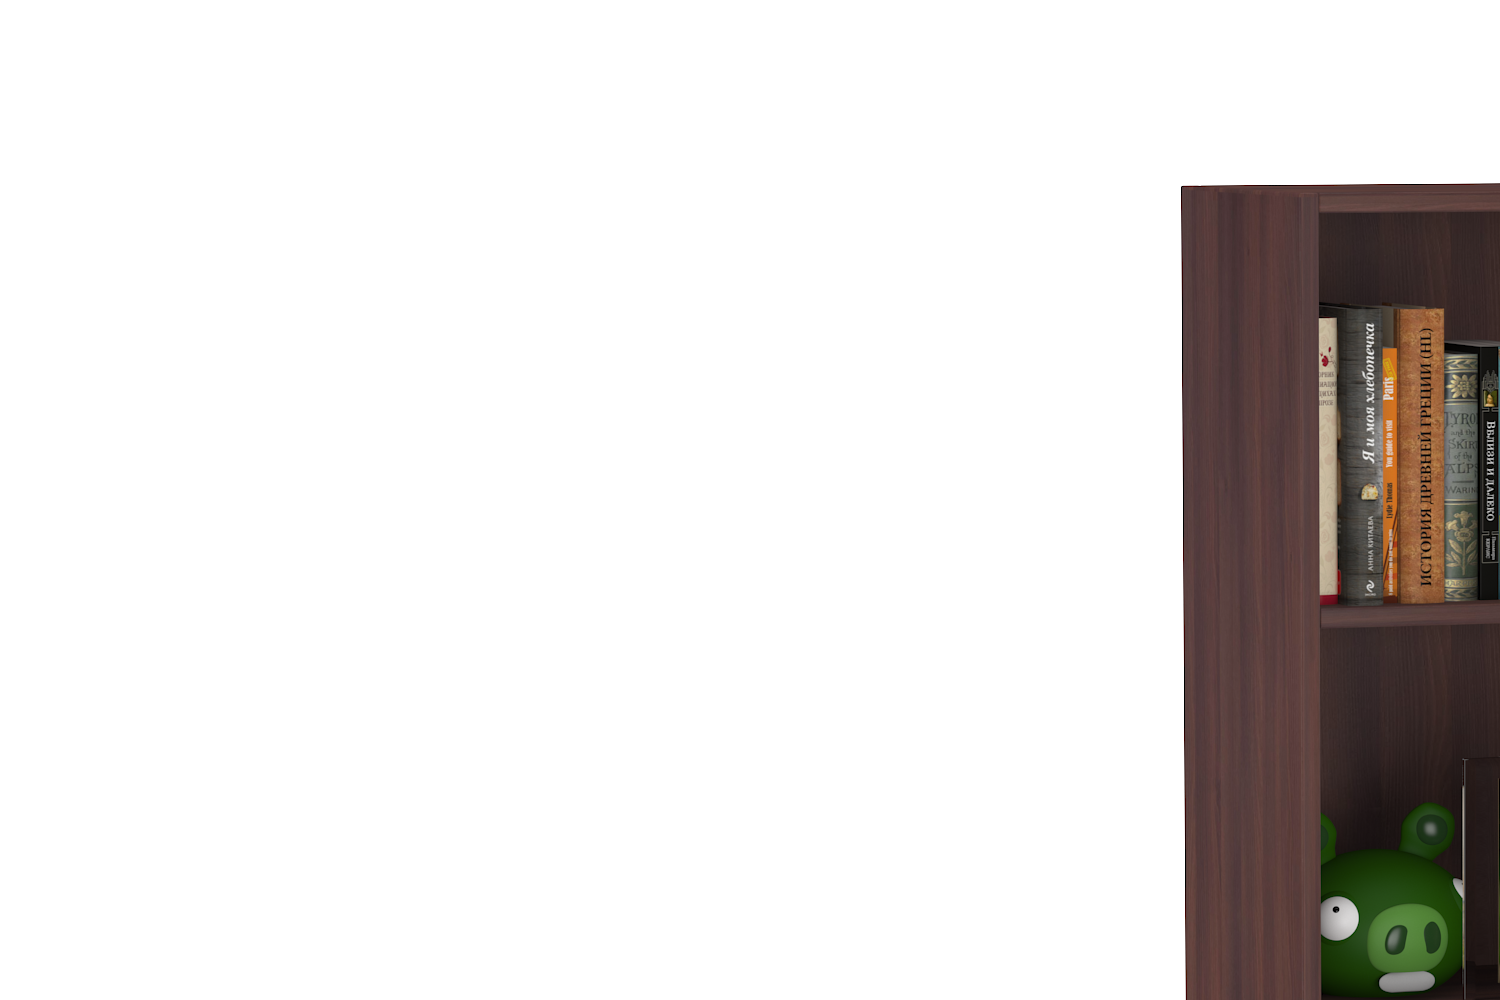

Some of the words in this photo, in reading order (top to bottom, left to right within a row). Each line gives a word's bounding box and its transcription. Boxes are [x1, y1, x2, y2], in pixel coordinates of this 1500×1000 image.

[1361, 322, 1375, 404] хлебопечка
[1383, 377, 1394, 401] Paris
[1420, 363, 1434, 427] ГРЕЦИИ
[1366, 406, 1375, 435] моя
[1366, 438, 1375, 447] и
[1386, 439, 1394, 456] guide
[1362, 450, 1375, 464] Я
[1417, 431, 1434, 504] ДРЕВНЕЙ
[1445, 485, 1478, 494] WARIN
[1420, 508, 1432, 586] ИСТОРИЯ
